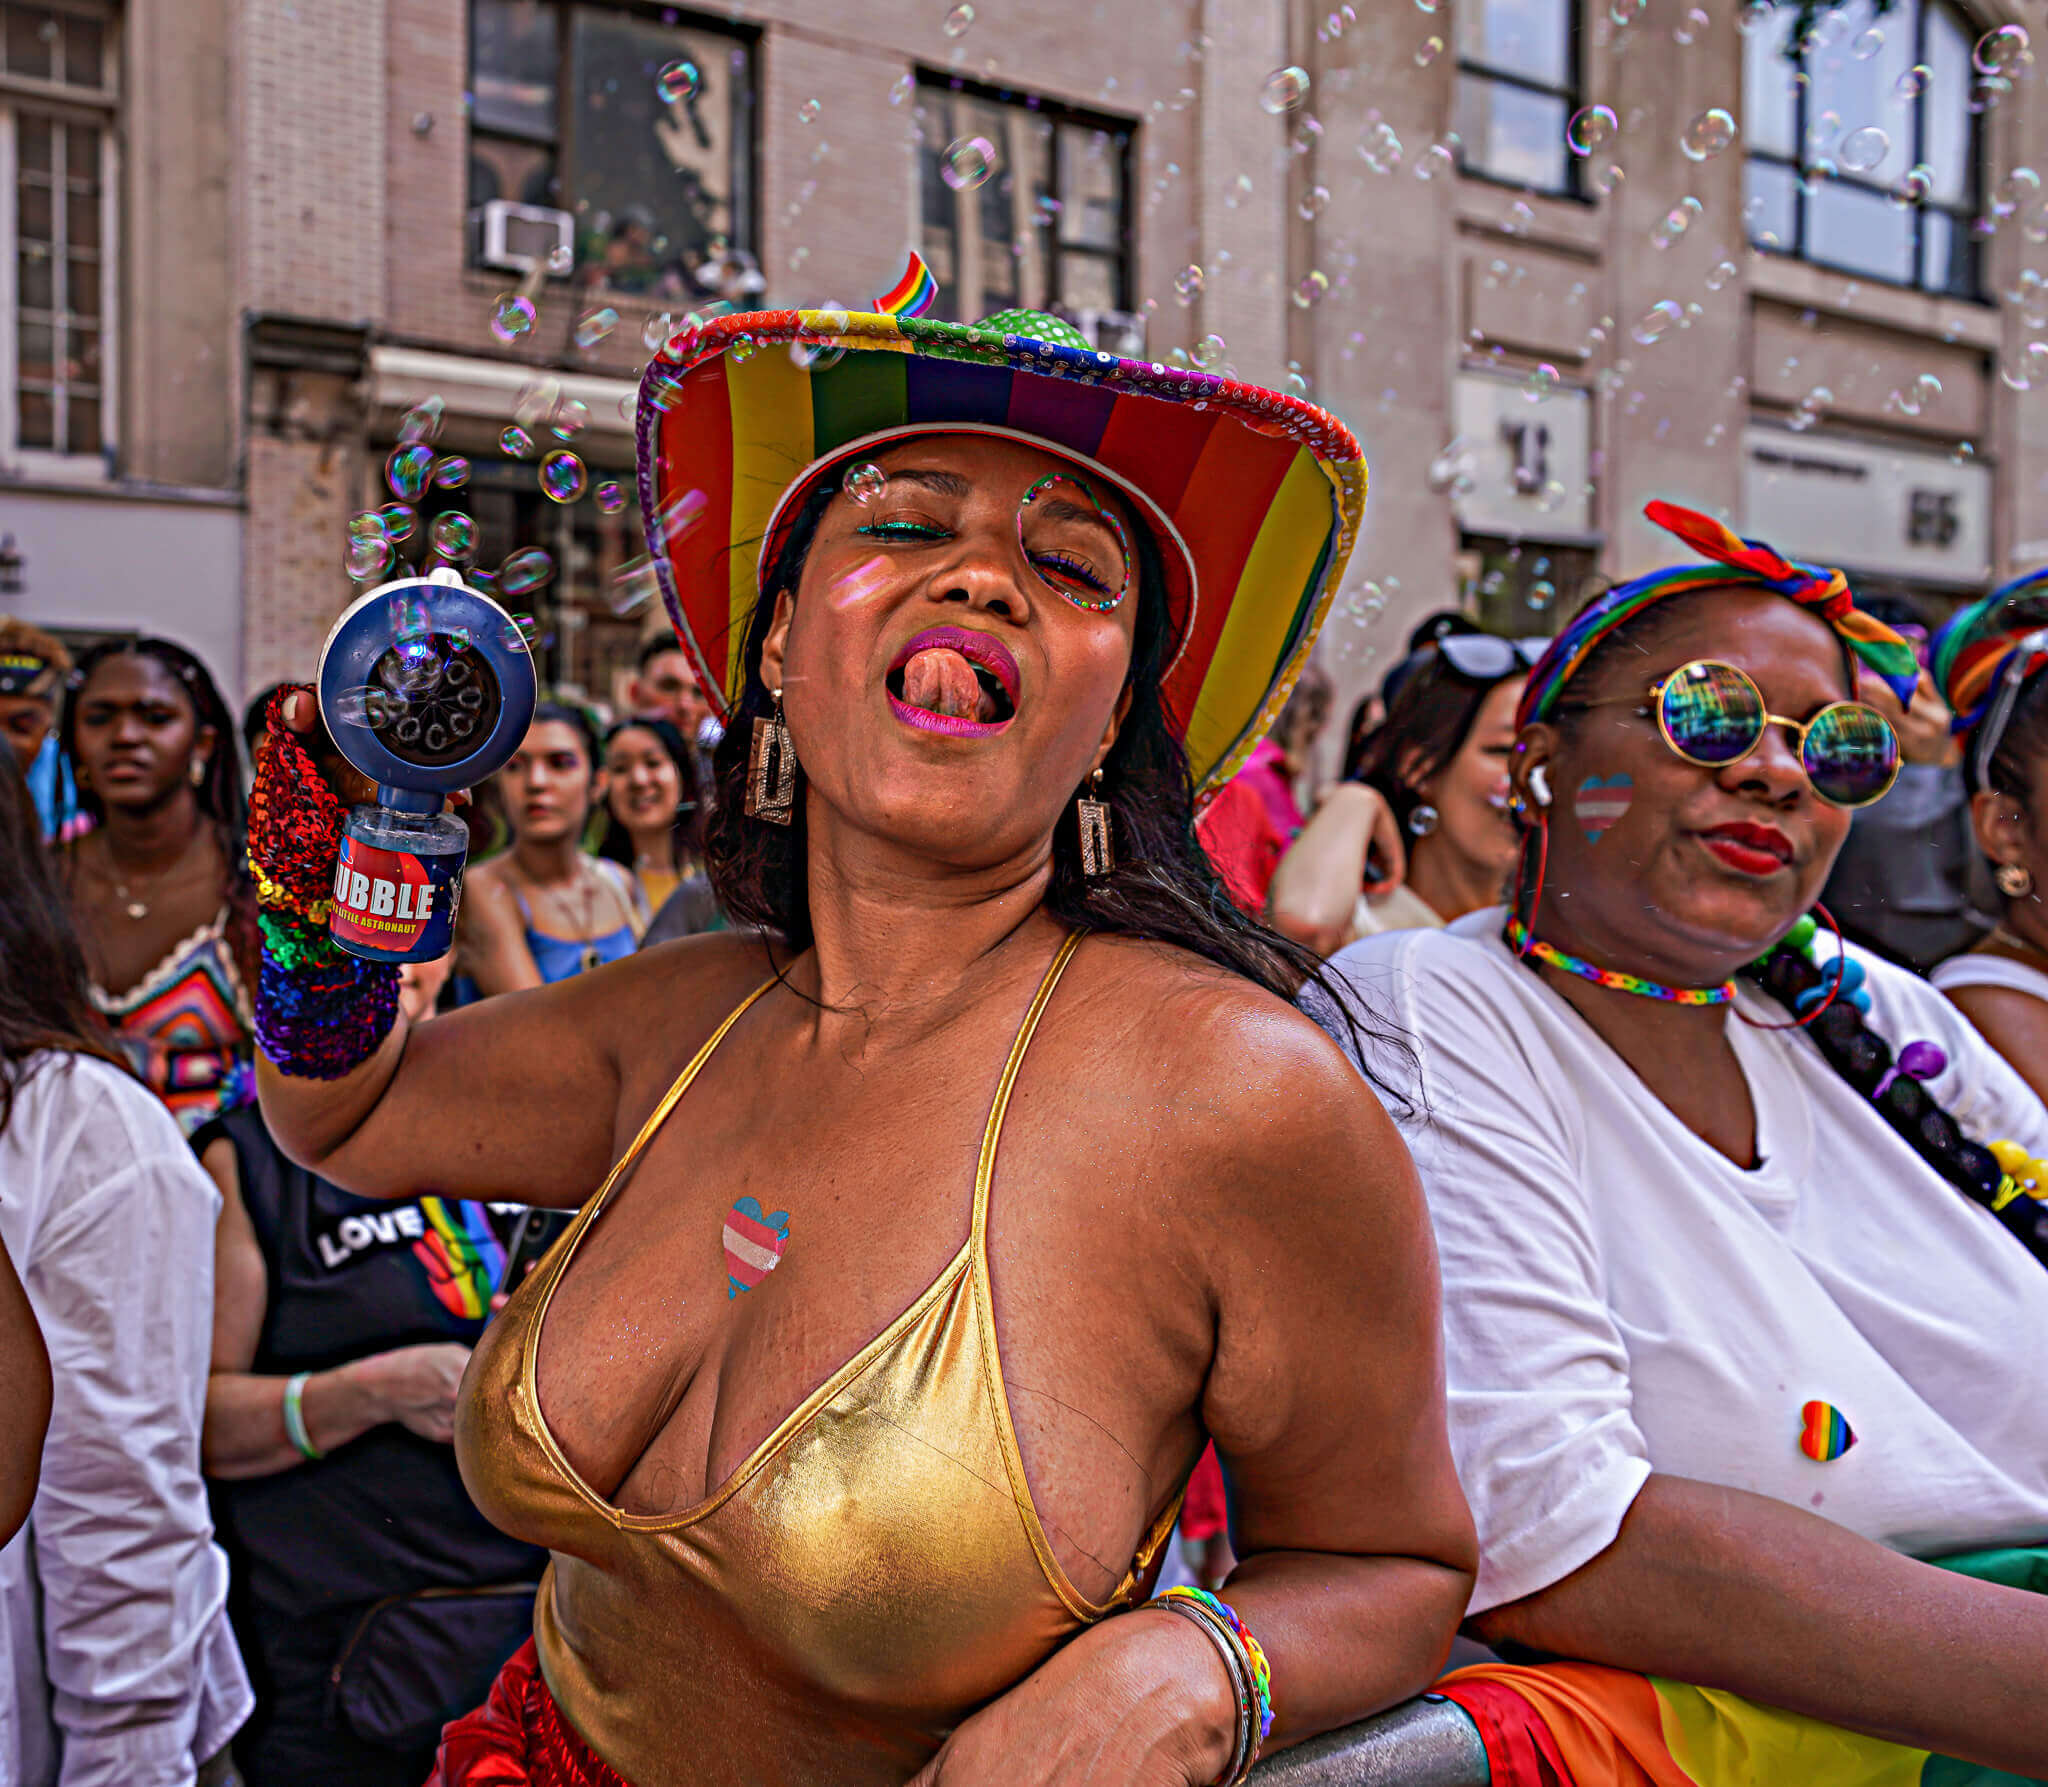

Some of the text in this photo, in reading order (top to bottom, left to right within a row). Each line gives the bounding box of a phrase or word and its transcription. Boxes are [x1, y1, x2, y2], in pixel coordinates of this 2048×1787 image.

[334, 862, 436, 920] UBBLE
[339, 906, 360, 925] LITTLE
[360, 917, 417, 934] ASTRONAUT
[318, 1206, 425, 1269] LOVE
